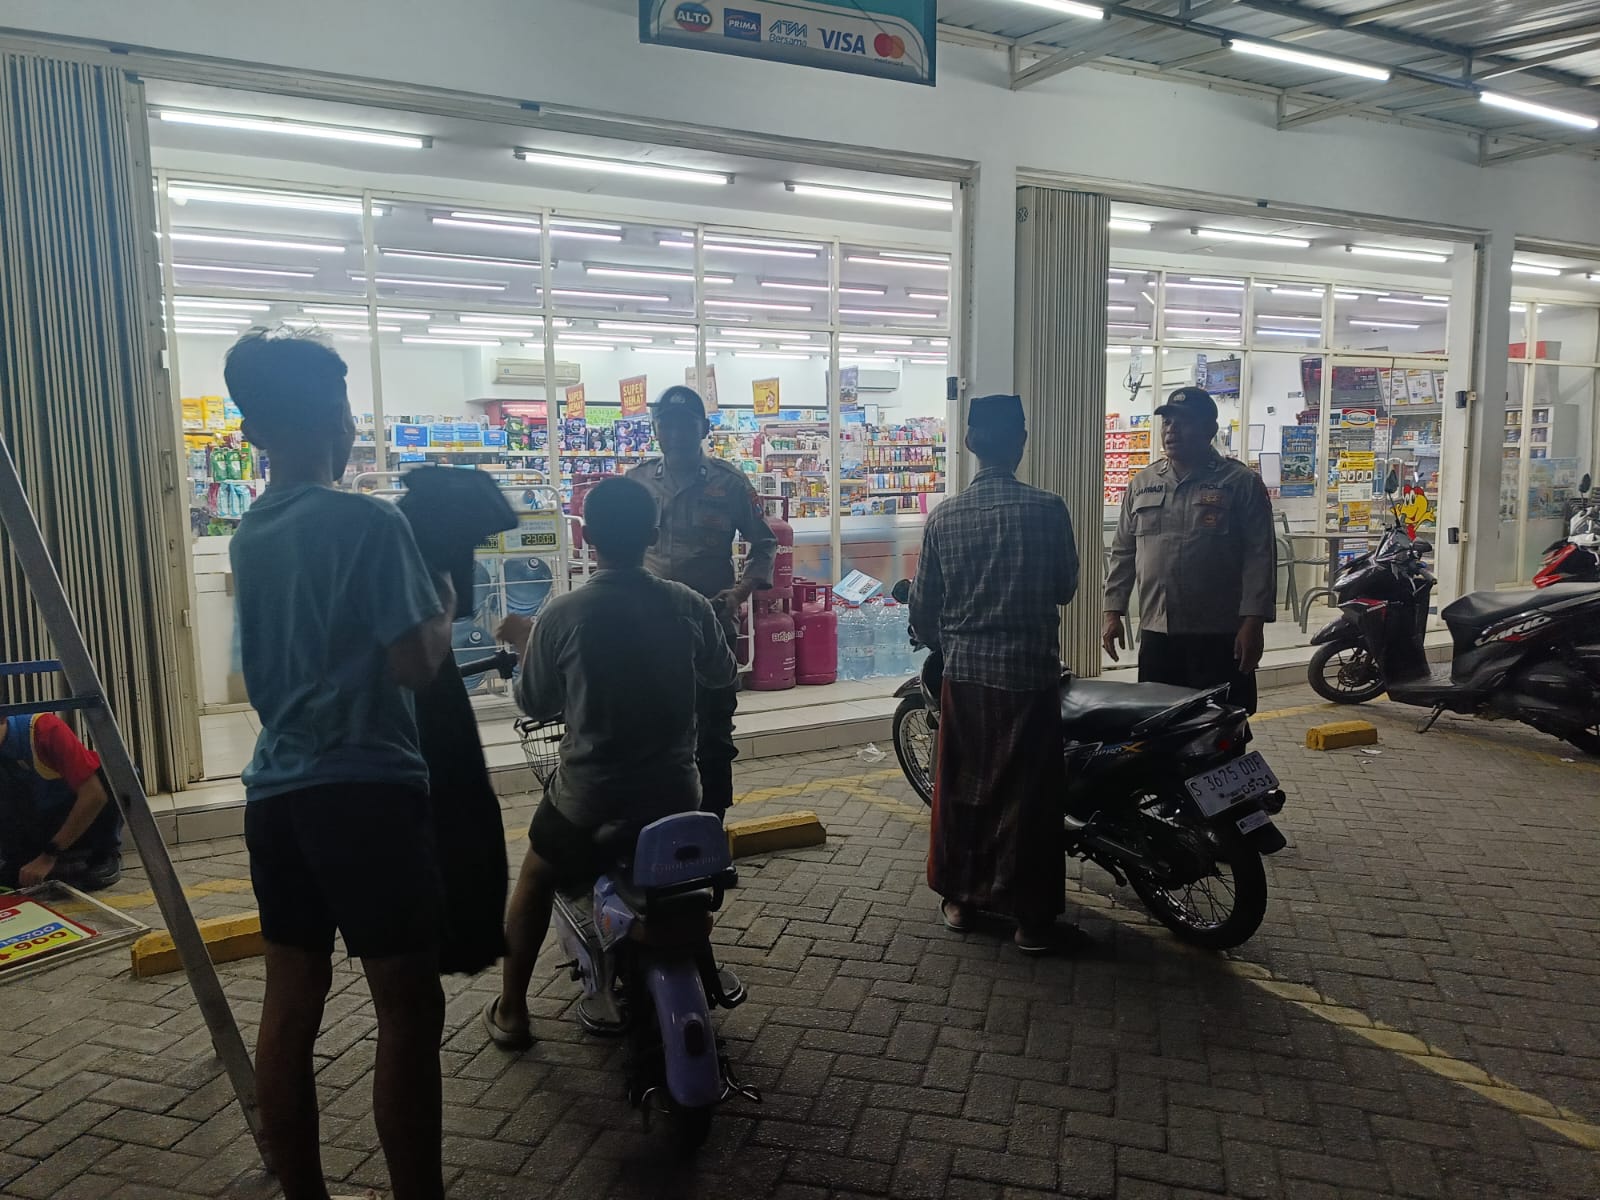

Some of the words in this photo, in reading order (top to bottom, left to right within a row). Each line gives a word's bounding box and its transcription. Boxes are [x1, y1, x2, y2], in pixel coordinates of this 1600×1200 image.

[676, 10, 712, 25] ALTO
[728, 18, 758, 33] PRIMA
[768, 19, 808, 37] ATM
[768, 33, 807, 47] Bersama
[817, 27, 866, 55] VISA
[622, 382, 644, 396] SUPER
[623, 394, 645, 408] HEMAT
[1190, 781, 1203, 798] S
[1203, 765, 1240, 791] 3675
